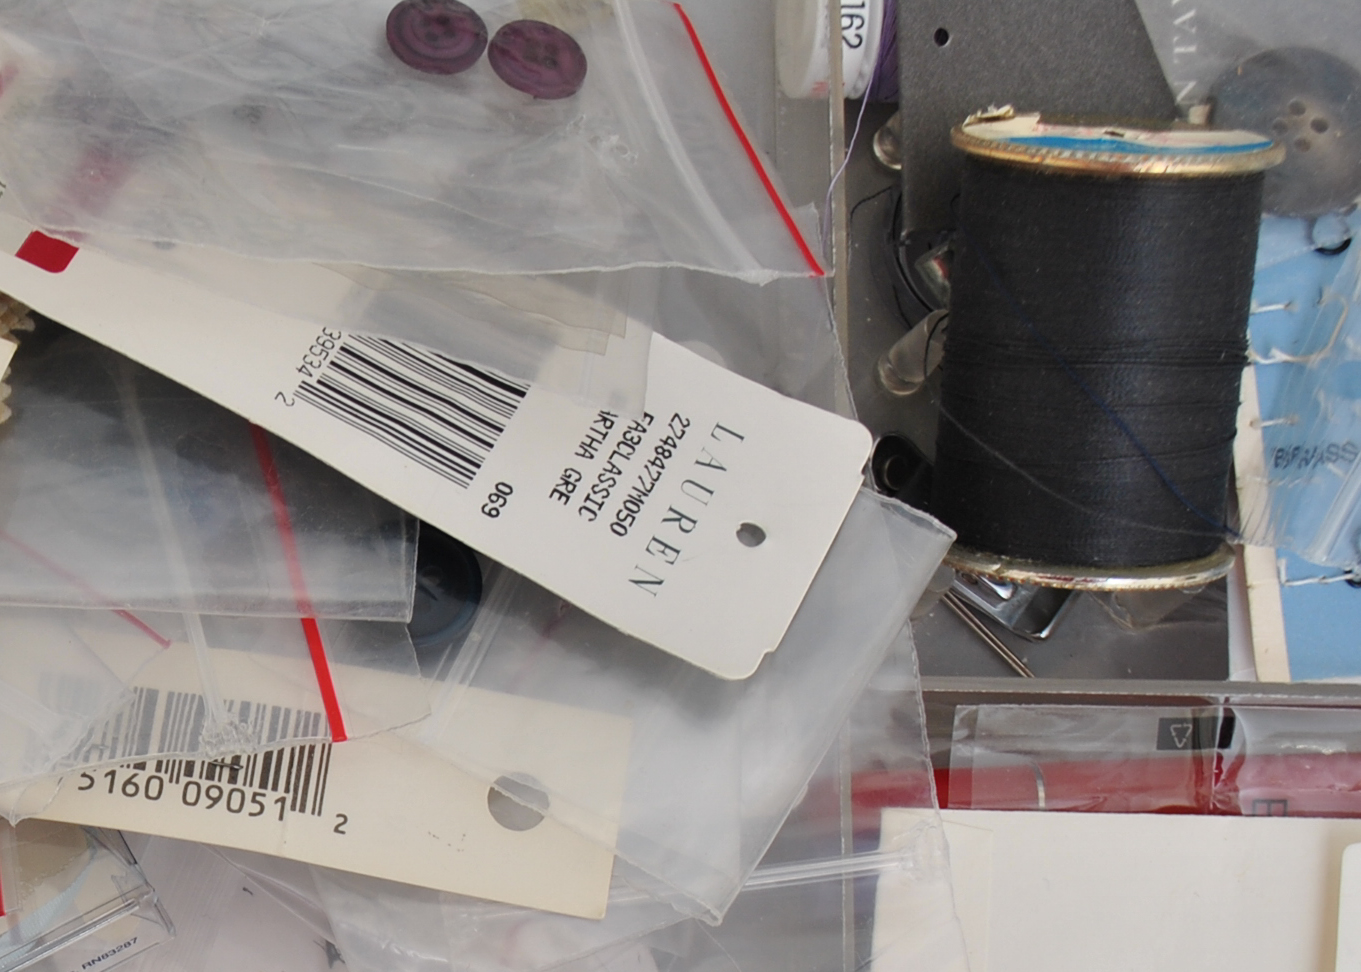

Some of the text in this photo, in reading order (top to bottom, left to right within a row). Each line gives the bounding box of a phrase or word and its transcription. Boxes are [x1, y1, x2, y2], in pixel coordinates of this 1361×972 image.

[275, 326, 341, 407] 39534 2
[481, 481, 514, 518] 069
[549, 467, 582, 505] GRE
[610, 413, 691, 537] 2748477M050
[629, 421, 745, 597] LAUREN
[182, 780, 288, 821] 09051
[333, 813, 349, 834] 2
